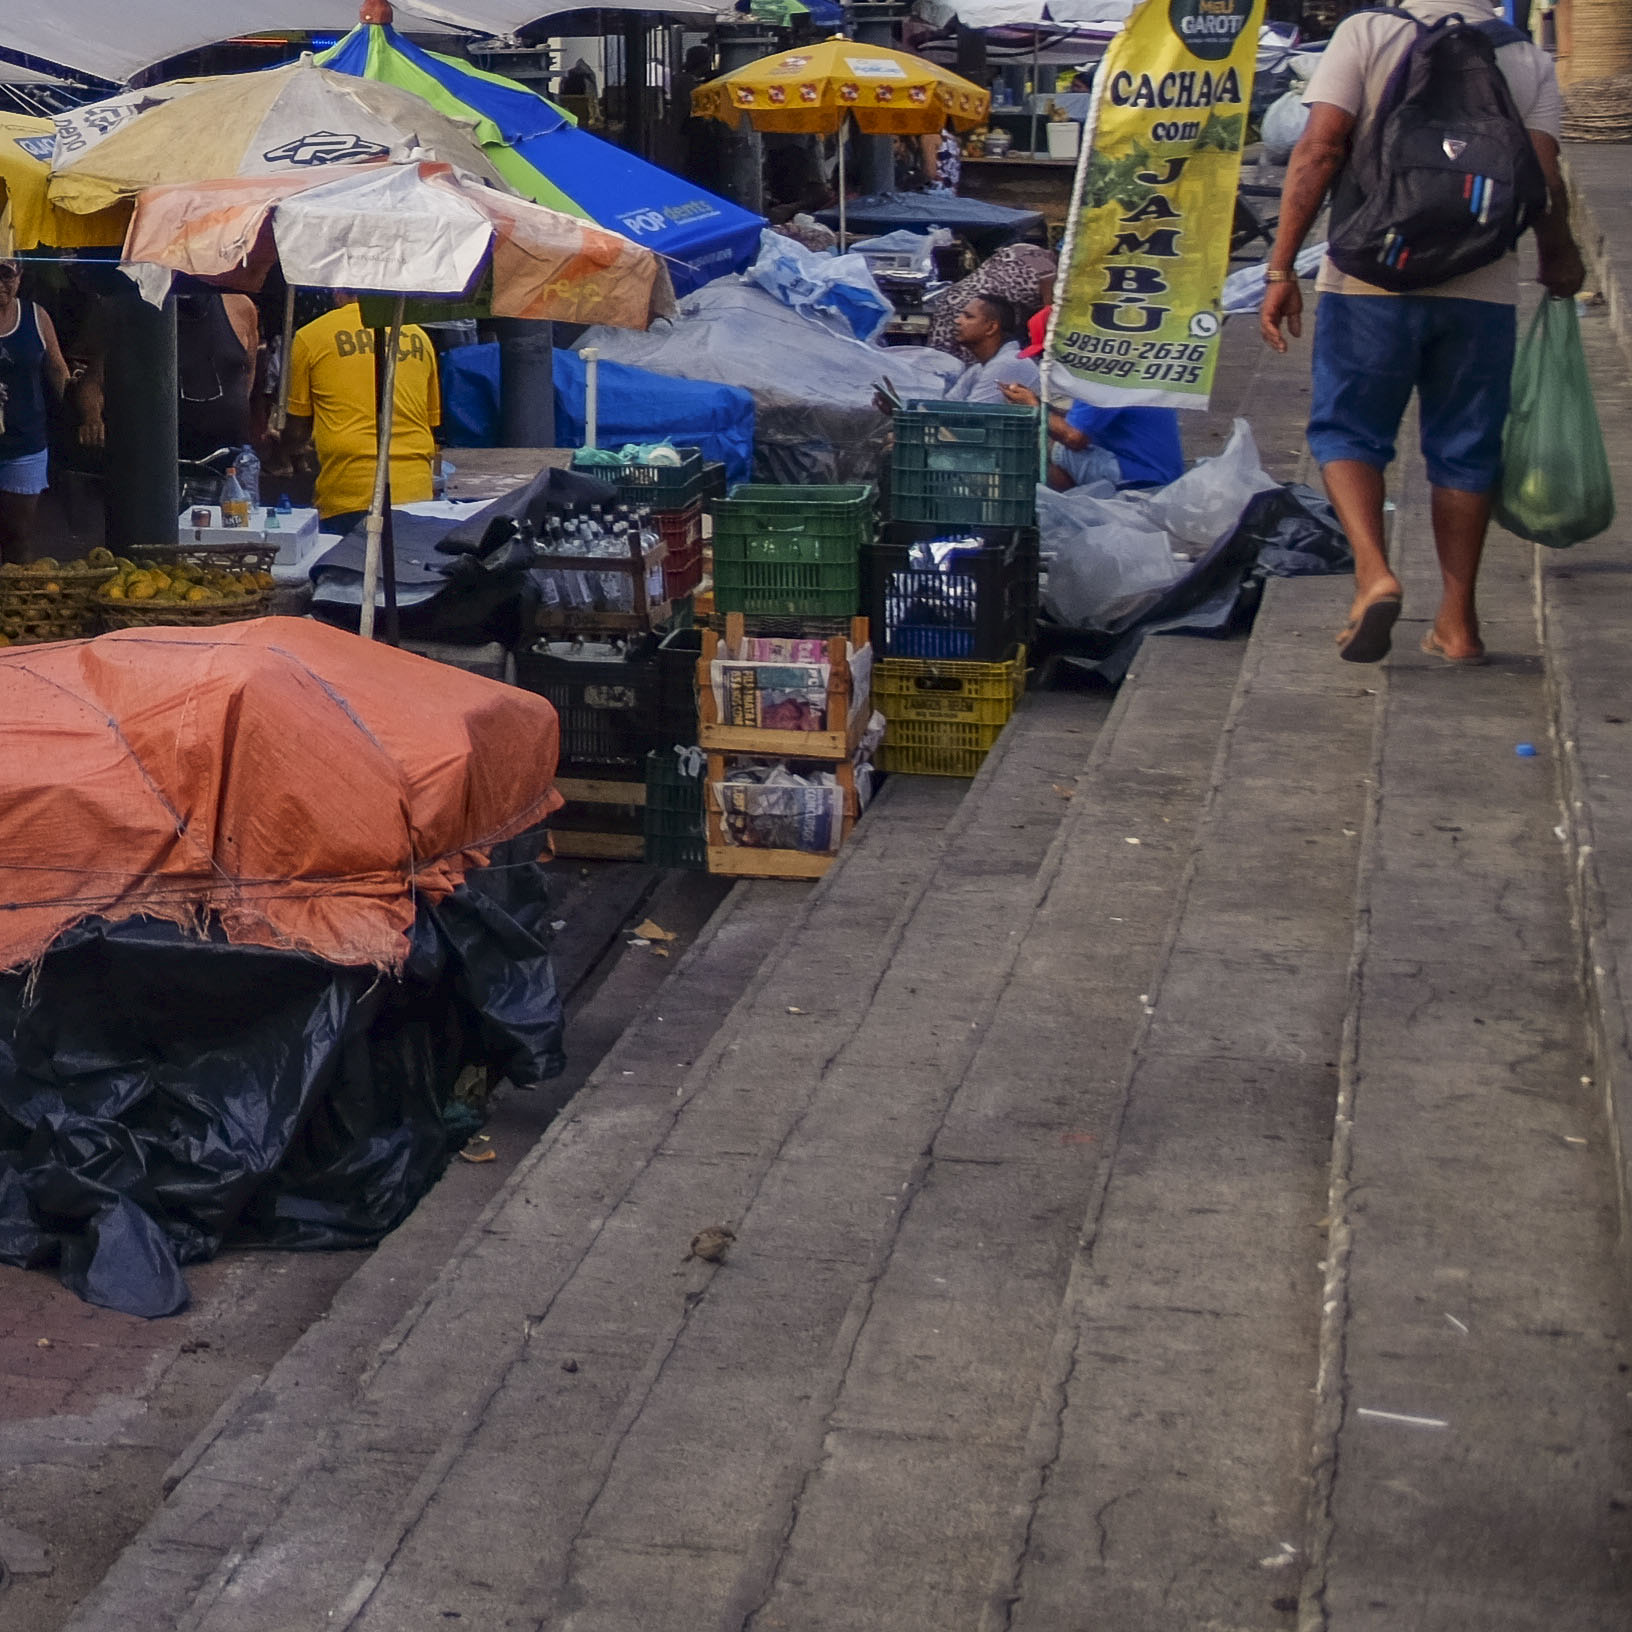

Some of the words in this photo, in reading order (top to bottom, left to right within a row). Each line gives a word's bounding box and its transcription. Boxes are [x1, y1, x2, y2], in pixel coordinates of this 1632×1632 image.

[1151, 121, 1200, 141] com
[623, 211, 667, 236] POP
[1090, 157, 1189, 333] JAMBÚ
[335, 329, 425, 362] BAÇA
